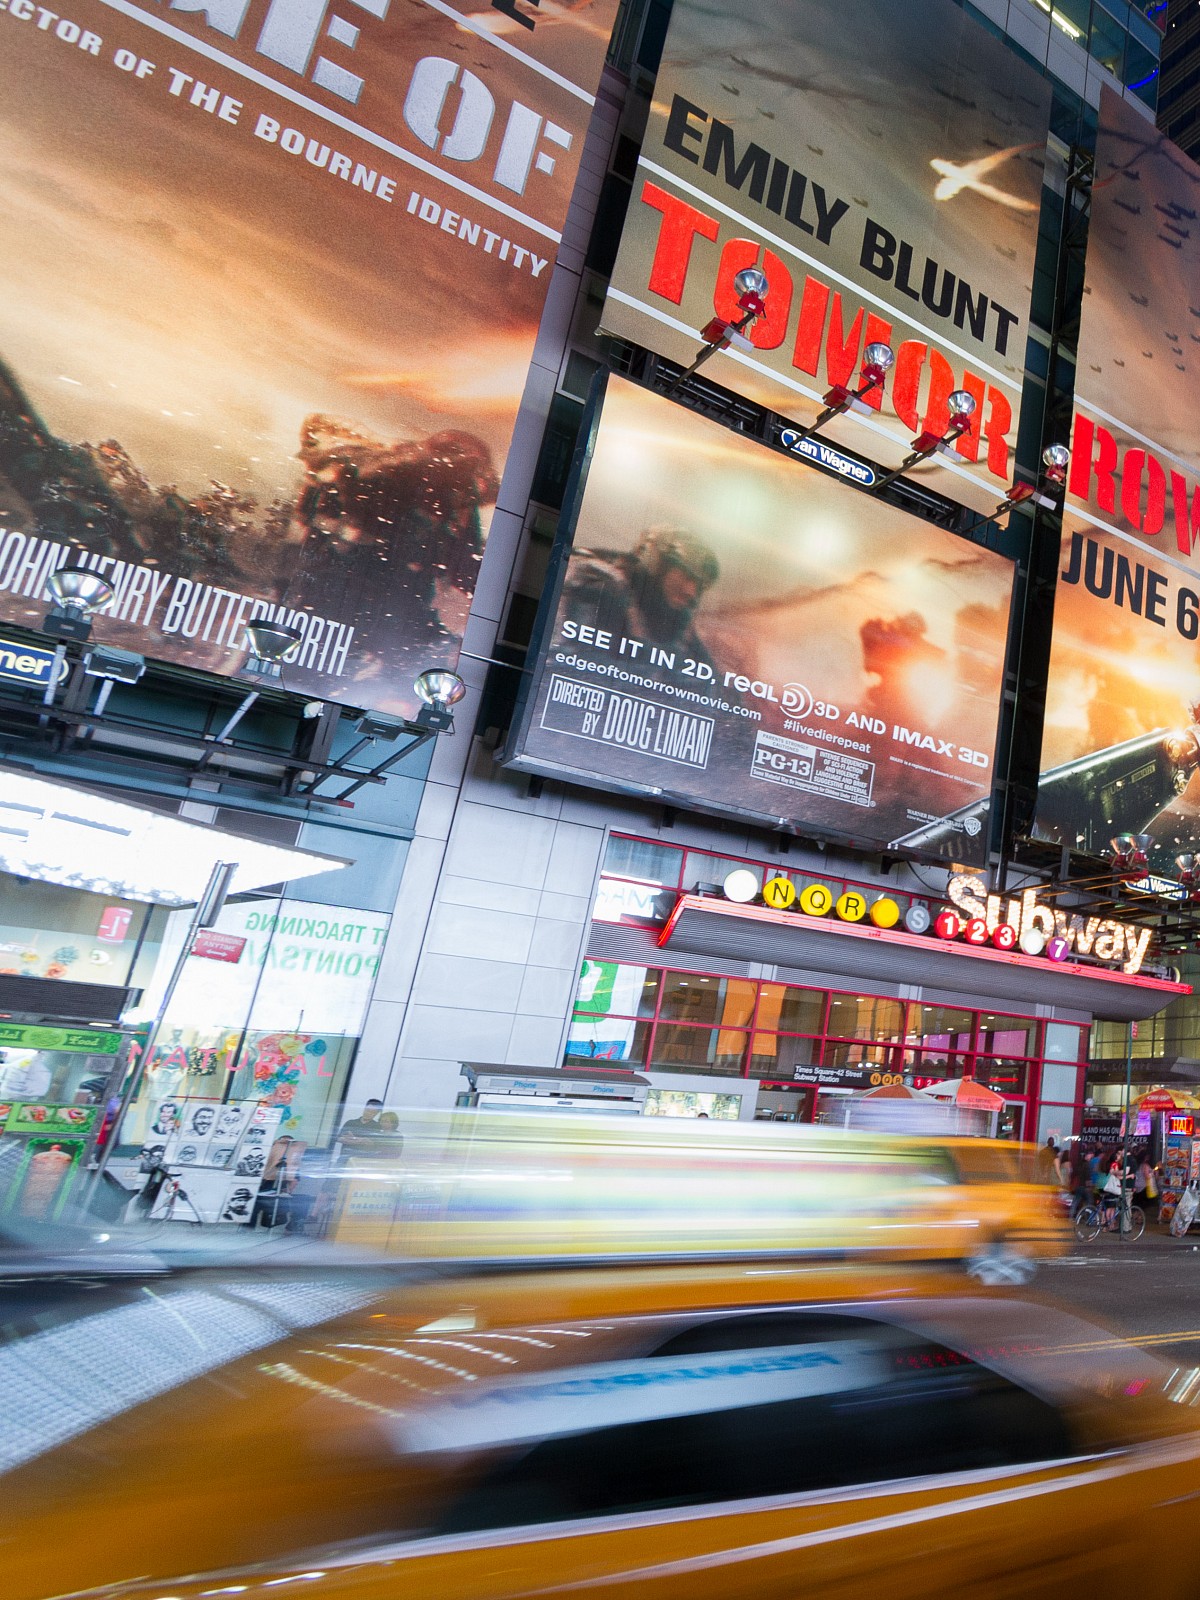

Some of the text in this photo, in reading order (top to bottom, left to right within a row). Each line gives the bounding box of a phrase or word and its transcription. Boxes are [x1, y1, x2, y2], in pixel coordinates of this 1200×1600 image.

[404, 56, 572, 196] OF
[114, 48, 156, 79] OF
[168, 66, 243, 125] THE
[254, 113, 397, 203] BOURNE
[407, 192, 549, 278] IDENTITY
[663, 94, 1018, 357] EMILY BLUNT
[820, 447, 868, 480] Wagner
[1062, 532, 1199, 641] JUNE 6
[552, 679, 605, 712] DIRECTED
[555, 652, 762, 721] edgeoftomorrowmovie.com
[561, 620, 612, 650] SEE
[619, 637, 643, 658] IT
[650, 647, 675, 670] IN
[682, 658, 716, 685] 2D,
[814, 700, 840, 720] 3D
[845, 712, 886, 735] AND
[958, 747, 989, 768] 3D
[581, 712, 600, 736] BY
[602, 694, 711, 764] DOUG LIMAN
[783, 719, 871, 754] #livedierepeat
[755, 748, 811, 776] PG-13
[942, 875, 1152, 974] Subway
[69, 1035, 100, 1046] Food
[128, 1044, 334, 1077] NATURAL
[795, 1066, 813, 1075] Times
[846, 1070, 863, 1078] Street
[514, 1081, 614, 1094] Phone Phone
[794, 1073, 840, 1083] Subway Station
